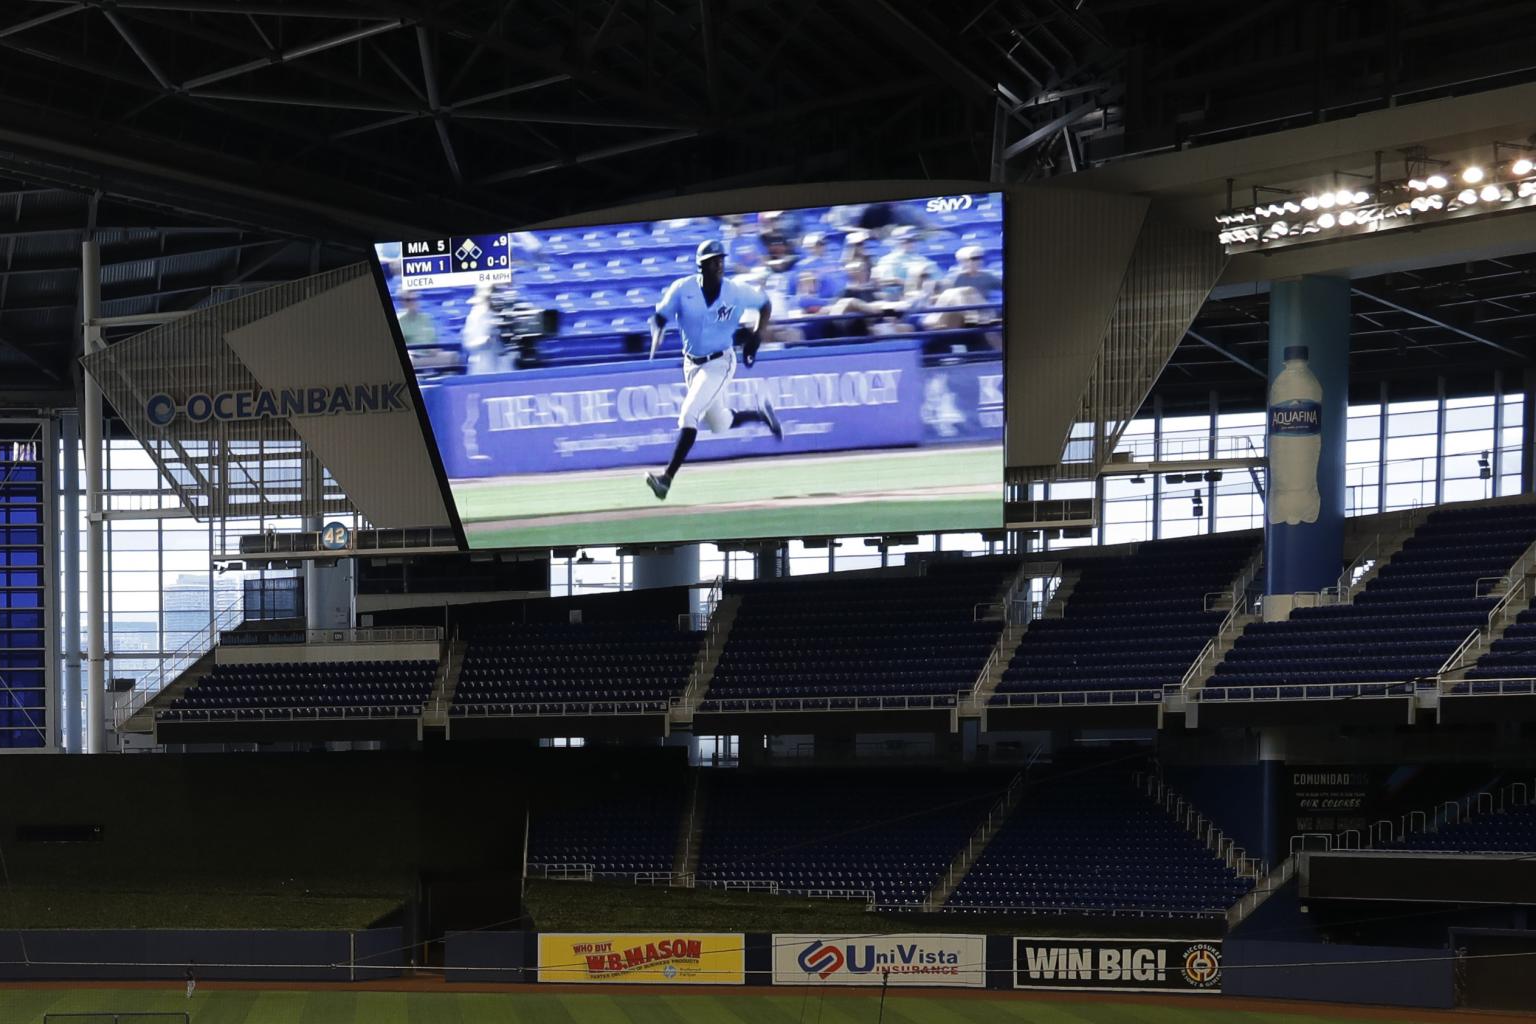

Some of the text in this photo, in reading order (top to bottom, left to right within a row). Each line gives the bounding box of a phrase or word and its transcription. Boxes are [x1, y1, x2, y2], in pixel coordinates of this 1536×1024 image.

[926, 196, 966, 213] SNY
[408, 239, 445, 254] MIA 5
[499, 235, 508, 246] 9
[406, 260, 445, 273] NYM 1
[487, 255, 507, 267] 0-0
[406, 278, 434, 288] UCETA
[479, 273, 510, 281] 84 MPH
[1272, 410, 1318, 426] AQUAFINA
[324, 527, 345, 544] 42
[573, 942, 612, 954] WHO BUT
[846, 944, 958, 972] UniVista
[1025, 947, 1167, 981] WIN BIG!
[876, 965, 959, 976] INSURANCE
